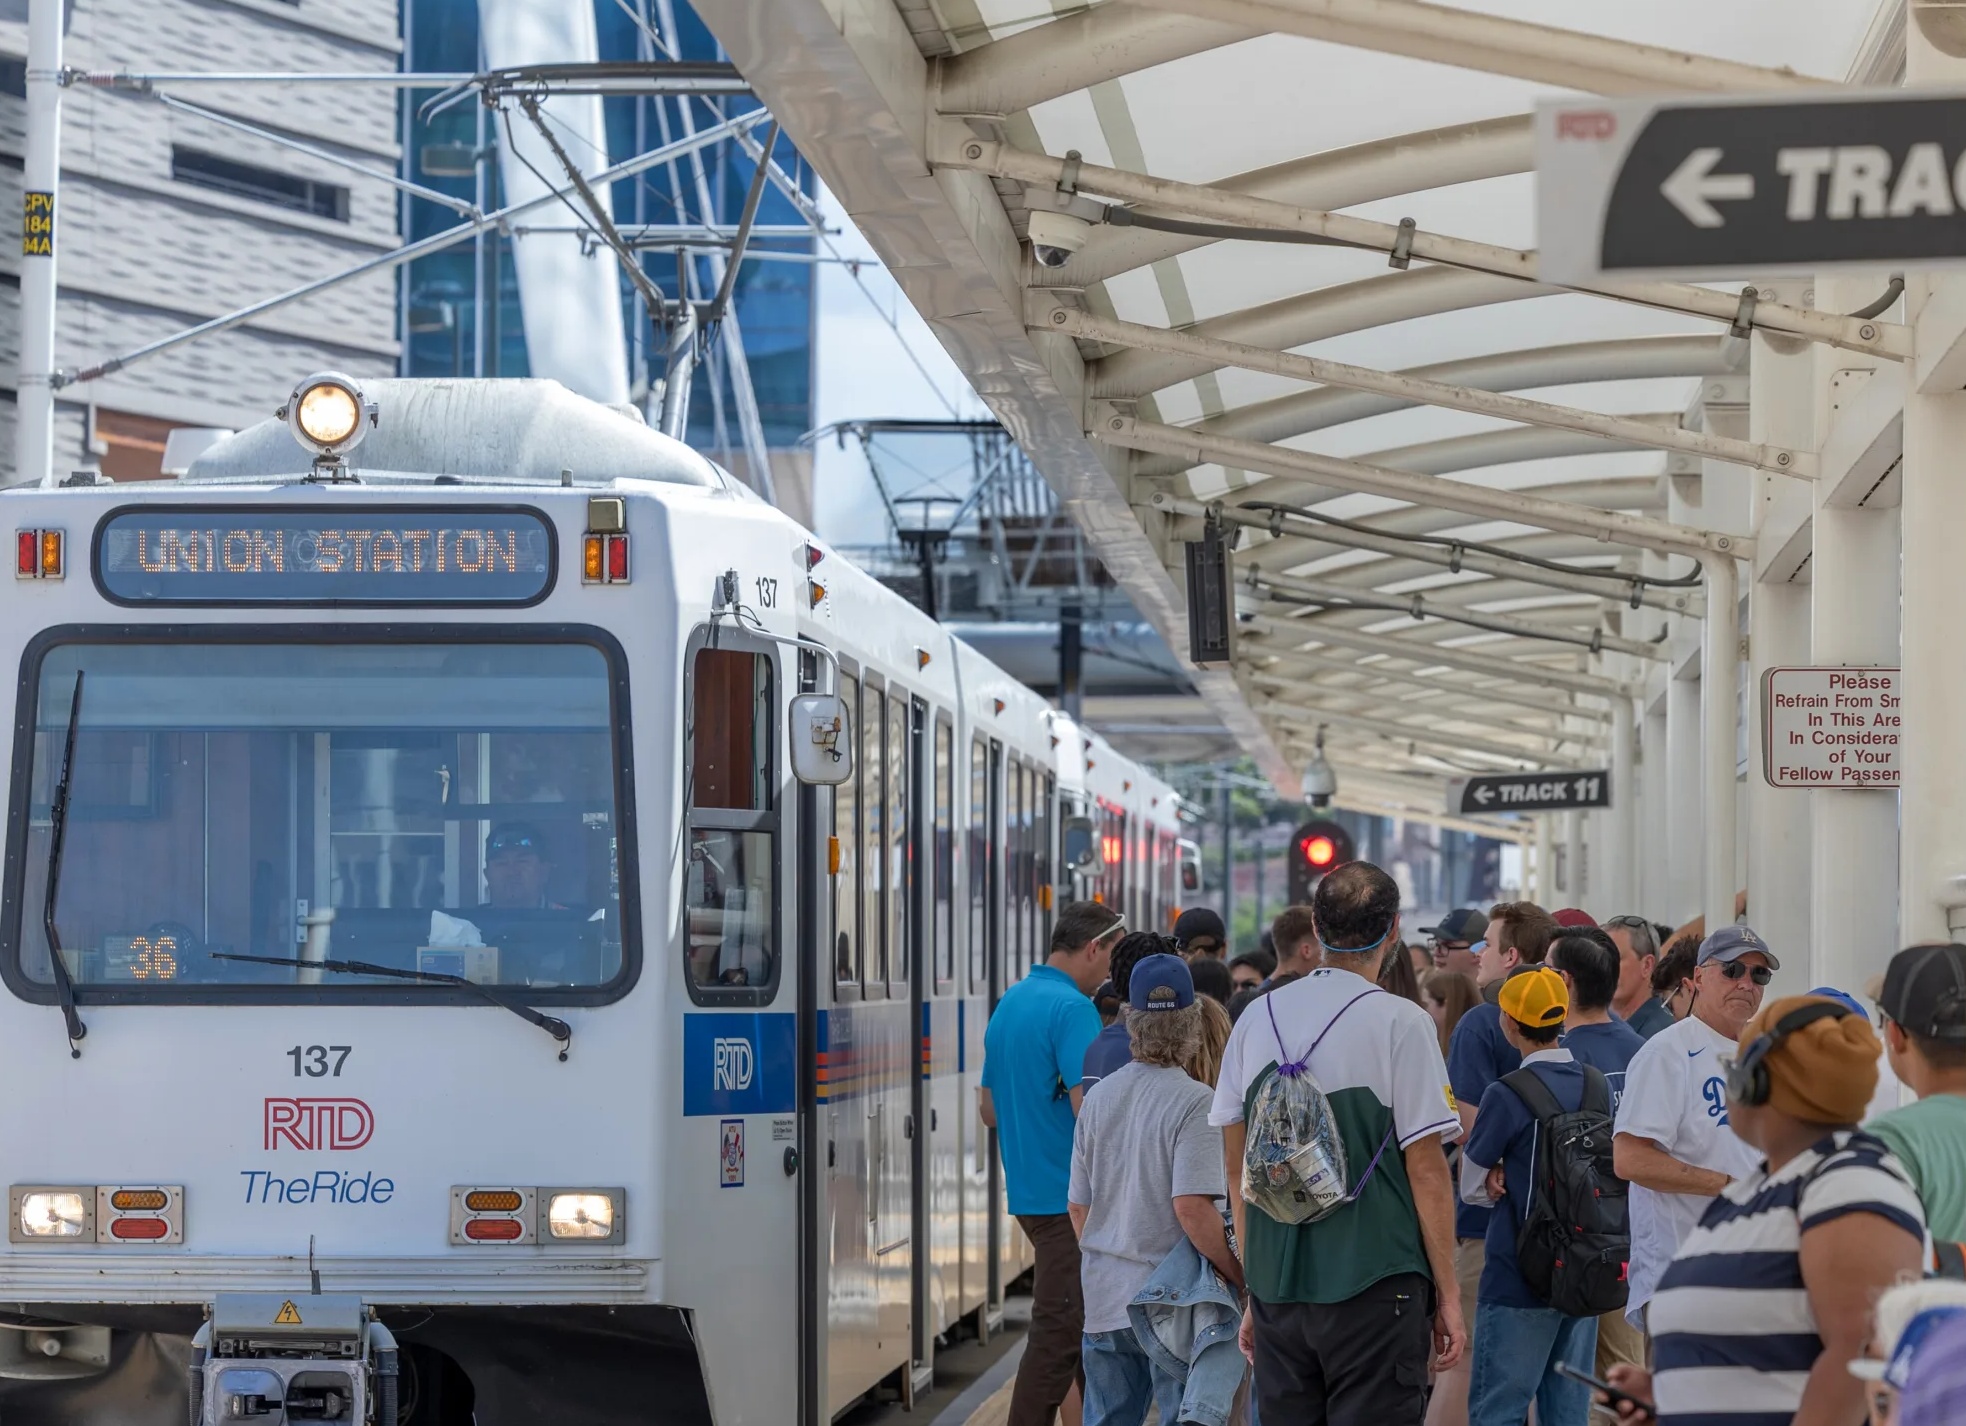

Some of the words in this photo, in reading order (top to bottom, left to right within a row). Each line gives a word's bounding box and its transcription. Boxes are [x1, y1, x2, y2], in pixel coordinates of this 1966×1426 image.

[1776, 142, 1966, 221] TRA
[138, 530, 283, 572] UNION
[315, 530, 516, 572] STATION
[755, 576, 777, 609] 137
[1829, 674, 1891, 689] Please
[1775, 694, 1828, 708] Refrain
[1835, 694, 1873, 708] From
[1808, 713, 1823, 726] In
[1830, 713, 1865, 726] This
[1789, 731, 1804, 744] In
[1812, 730, 1901, 744] Considera
[1829, 750, 1846, 763] of
[1854, 750, 1891, 763] Your
[1779, 767, 1833, 780] Fellow
[1499, 782, 1568, 803] TRACK
[1574, 777, 1600, 801] 11
[129, 936, 176, 979] 36
[286, 1045, 352, 1077] 137
[714, 1037, 753, 1090] RTD
[264, 1098, 374, 1150] RTD
[240, 1171, 394, 1203] TheRide
